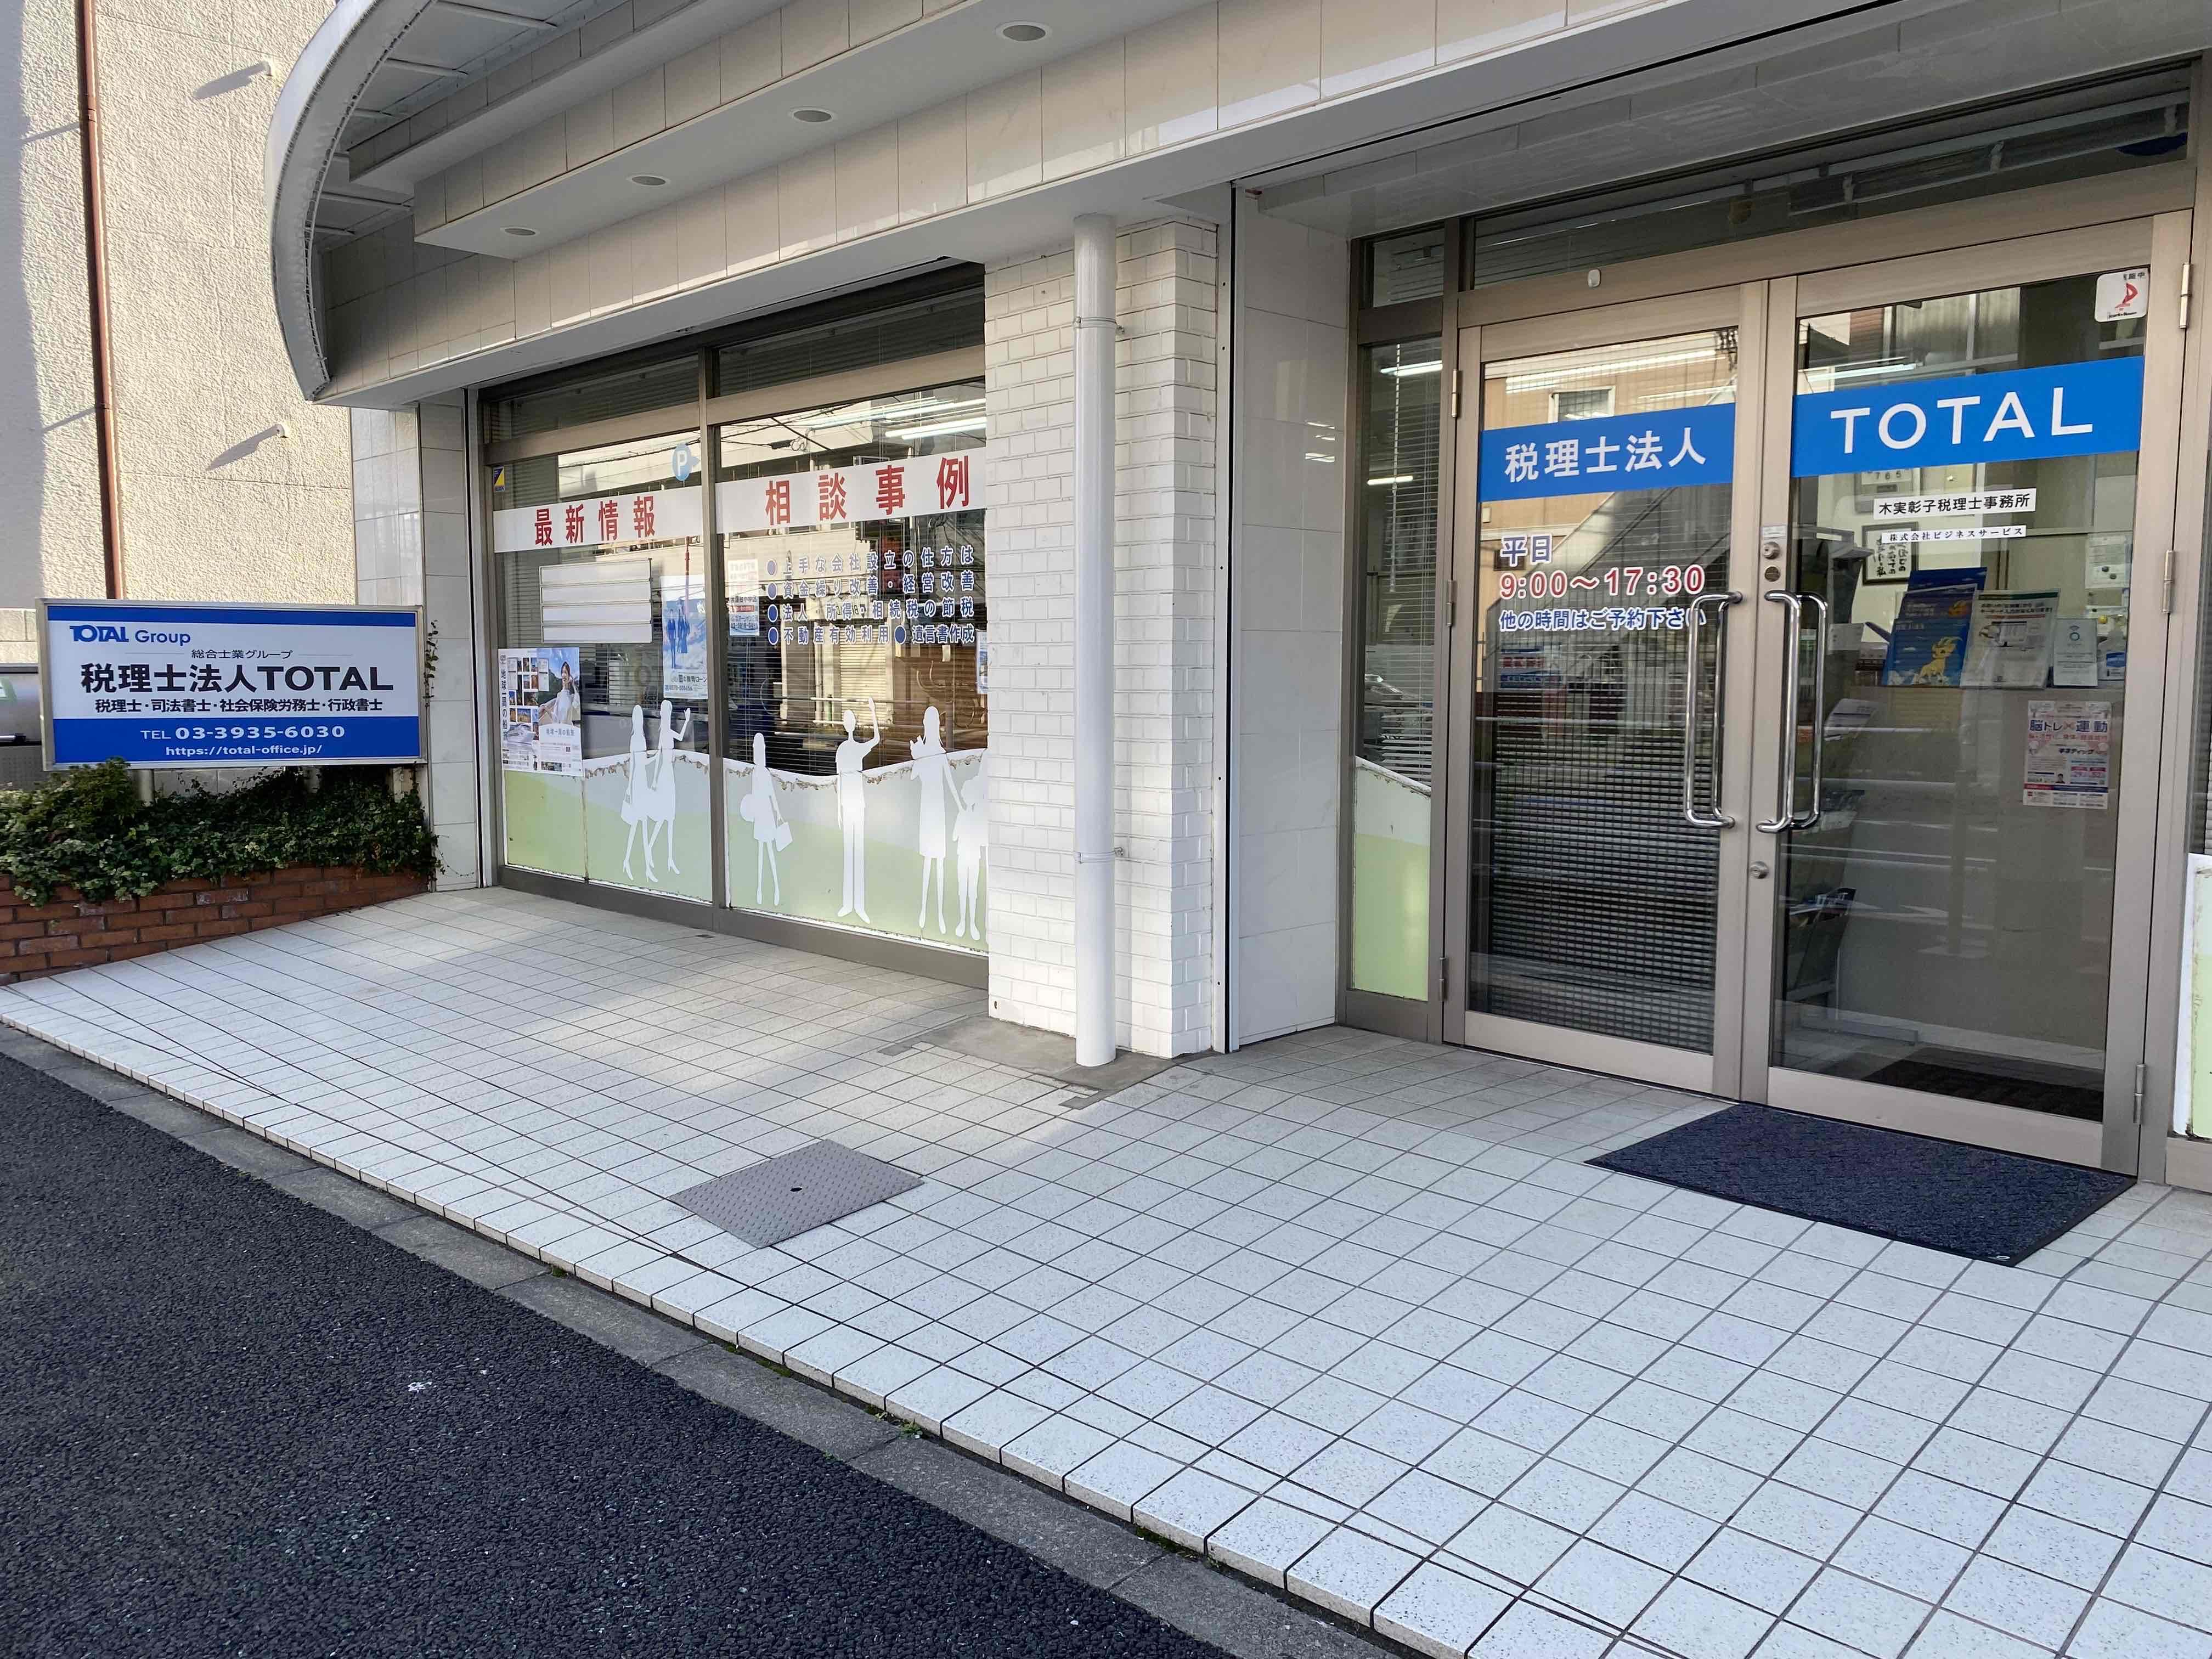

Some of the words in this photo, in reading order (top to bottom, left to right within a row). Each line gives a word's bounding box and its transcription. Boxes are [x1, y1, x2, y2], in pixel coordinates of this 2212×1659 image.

[1830, 387, 2093, 454] TOTAL
[1504, 427, 1706, 483] 税理士法人
[765, 455, 970, 526] 相談事例
[1878, 493, 2030, 515] 木実彰子税理士事務所
[534, 495, 656, 546] 最新情報
[1889, 527, 2023, 541] 株式会社ビジネスサービス
[783, 544, 974, 576] 上手な会社設立の仕方は
[1500, 532, 1553, 567] 平日
[783, 569, 975, 600] 資金繰り改善・経営改善
[70, 624, 129, 642] TOTAL
[134, 630, 191, 646] Group
[783, 624, 889, 646] 不動産有効利用
[911, 623, 975, 645] 遺言書作成
[191, 649, 294, 659] 総合士業グループ
[81, 663, 394, 693] 税理士法人TOTAL
[140, 730, 171, 740] TEL
[174, 726, 345, 740] 03-3935-6030
[165, 744, 323, 757] https://total-office.jp/
